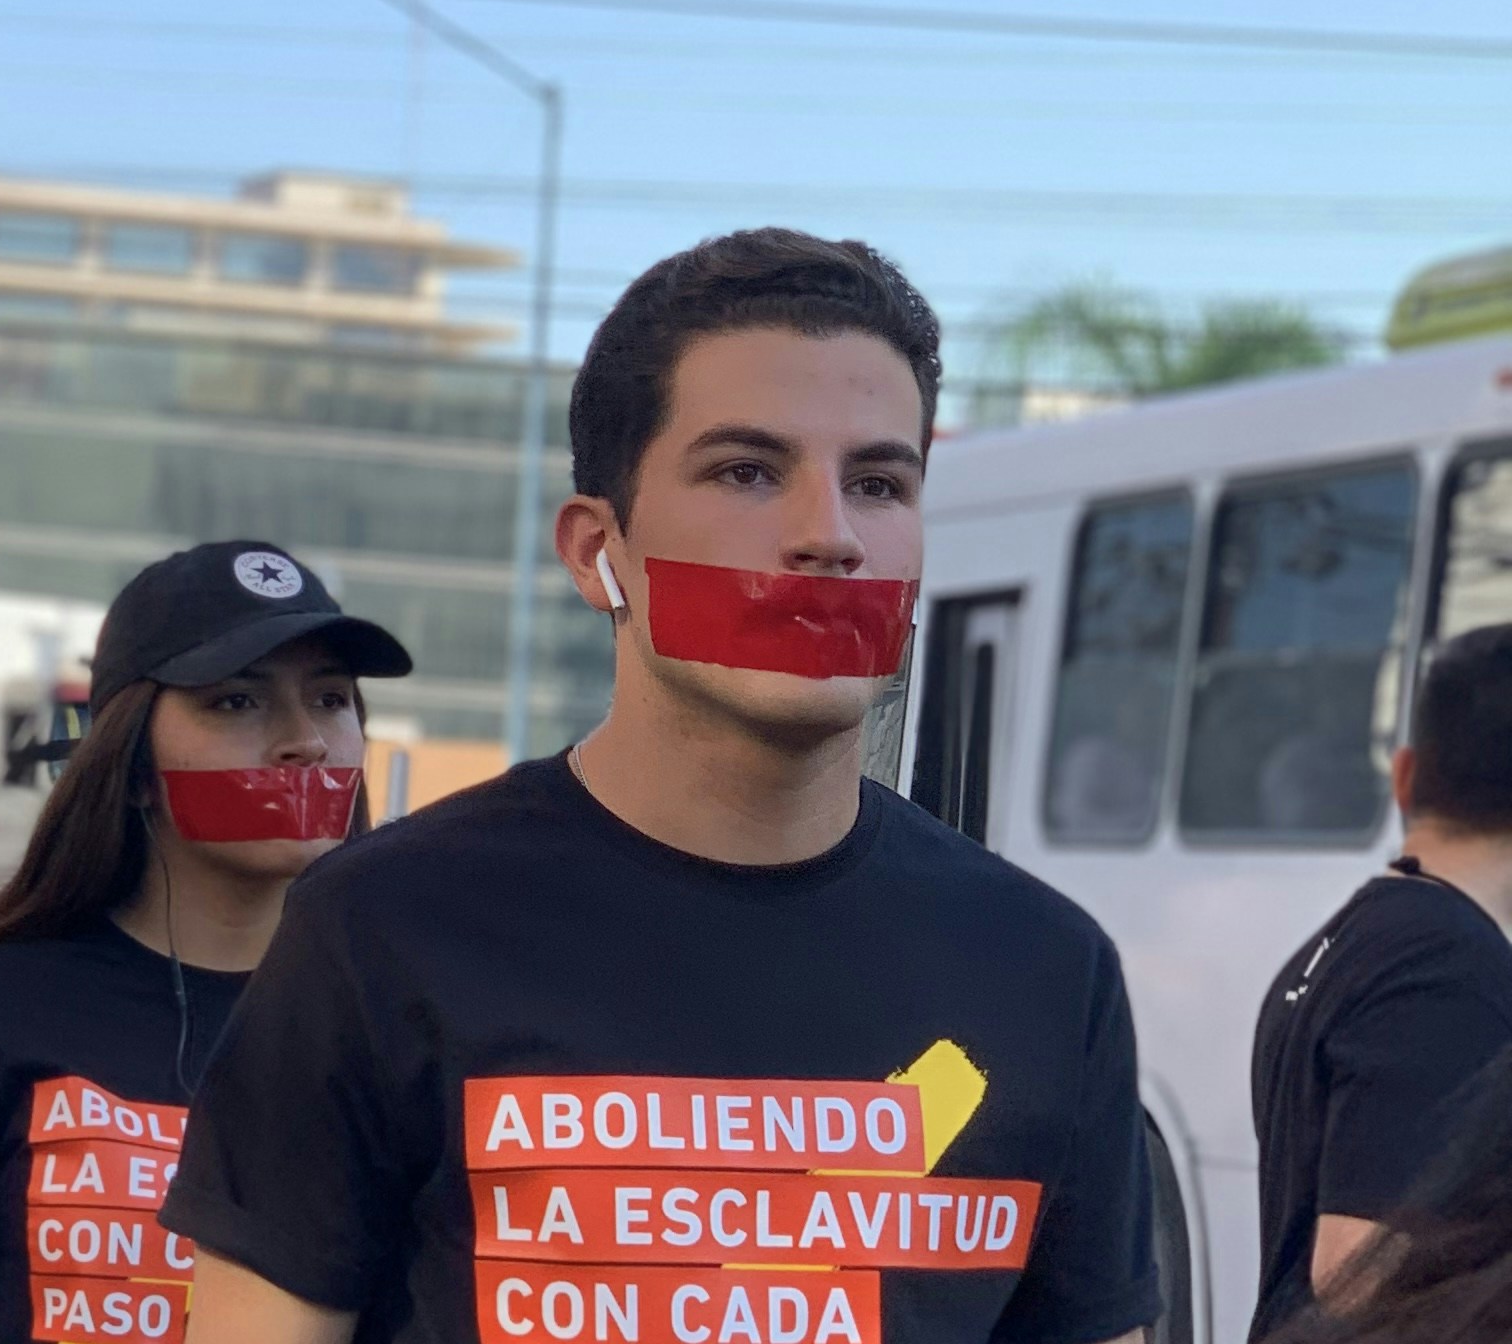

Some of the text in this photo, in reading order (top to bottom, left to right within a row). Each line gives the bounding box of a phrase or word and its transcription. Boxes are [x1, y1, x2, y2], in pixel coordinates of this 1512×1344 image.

[486, 1093, 907, 1154] ABOLIENDO
[41, 1153, 105, 1194] LA
[38, 1219, 143, 1266] CON
[493, 1186, 1018, 1252] LA ESCLAVITUD
[42, 1287, 171, 1337] PASO
[495, 1277, 862, 1344] CON CADA
